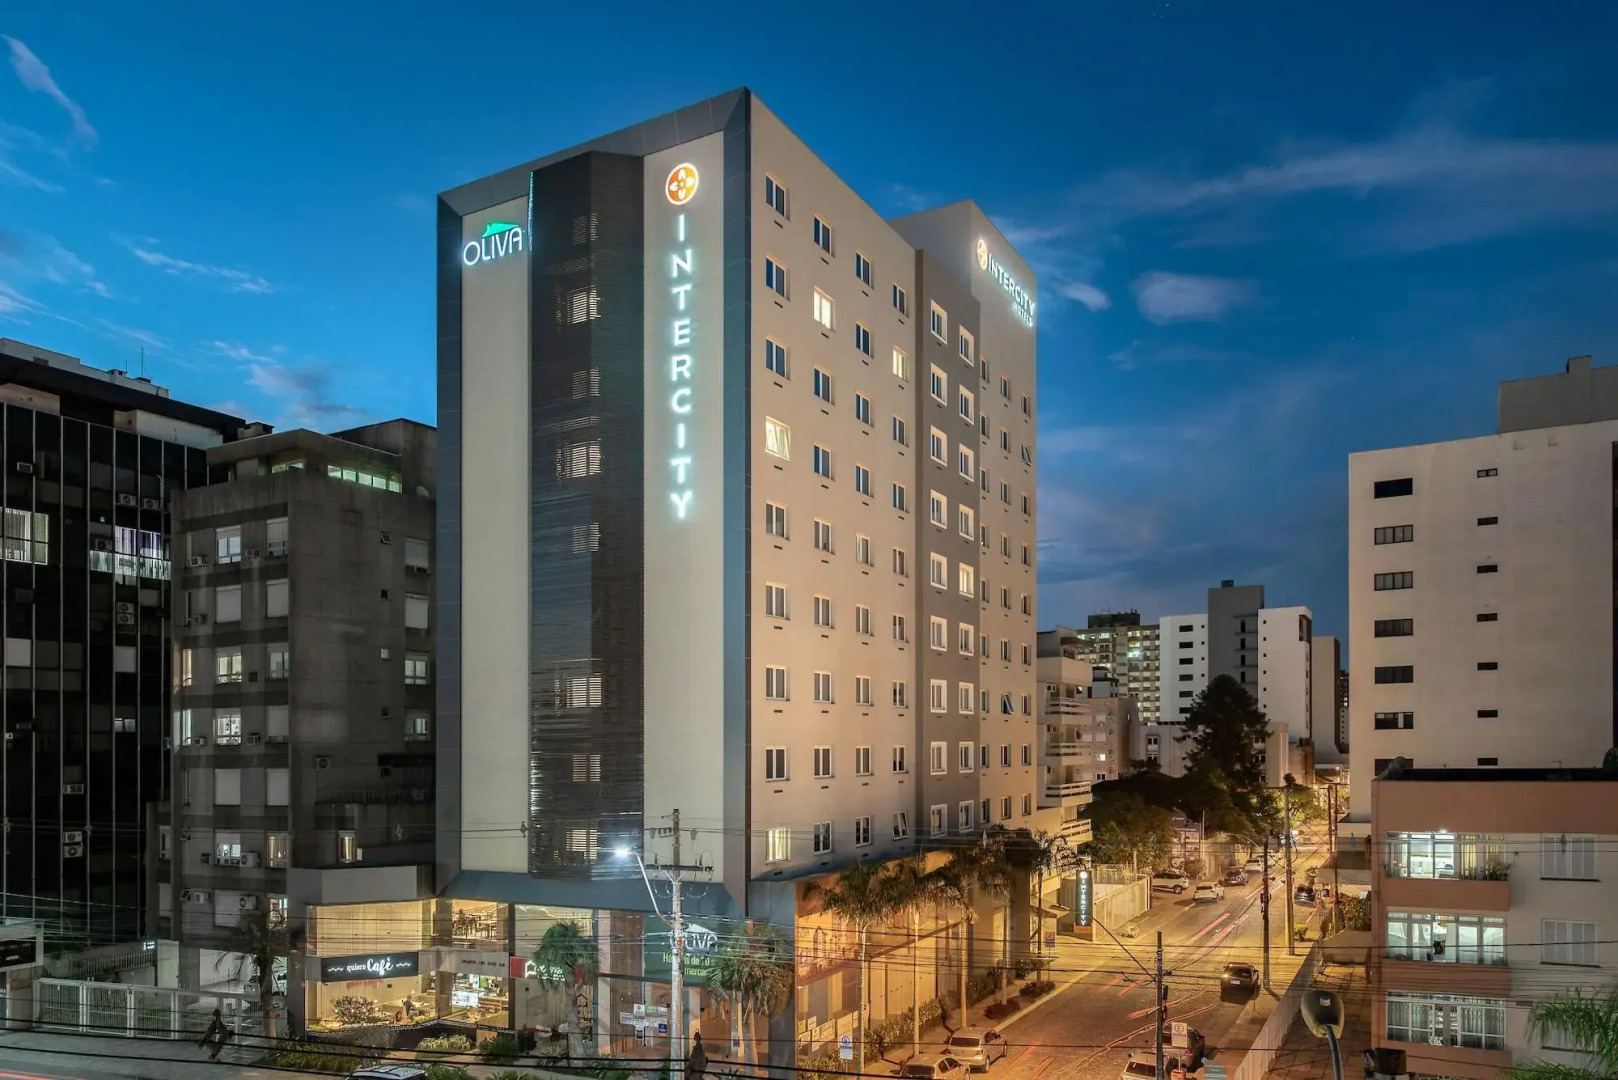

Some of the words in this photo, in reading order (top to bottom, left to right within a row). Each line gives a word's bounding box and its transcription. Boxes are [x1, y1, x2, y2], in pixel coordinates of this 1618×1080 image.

[462, 226, 523, 265] OLIVA
[988, 253, 1035, 316] INTERCITY
[671, 213, 694, 520] INTERCITY
[346, 963, 366, 973] quiero
[691, 956, 700, 965] de
